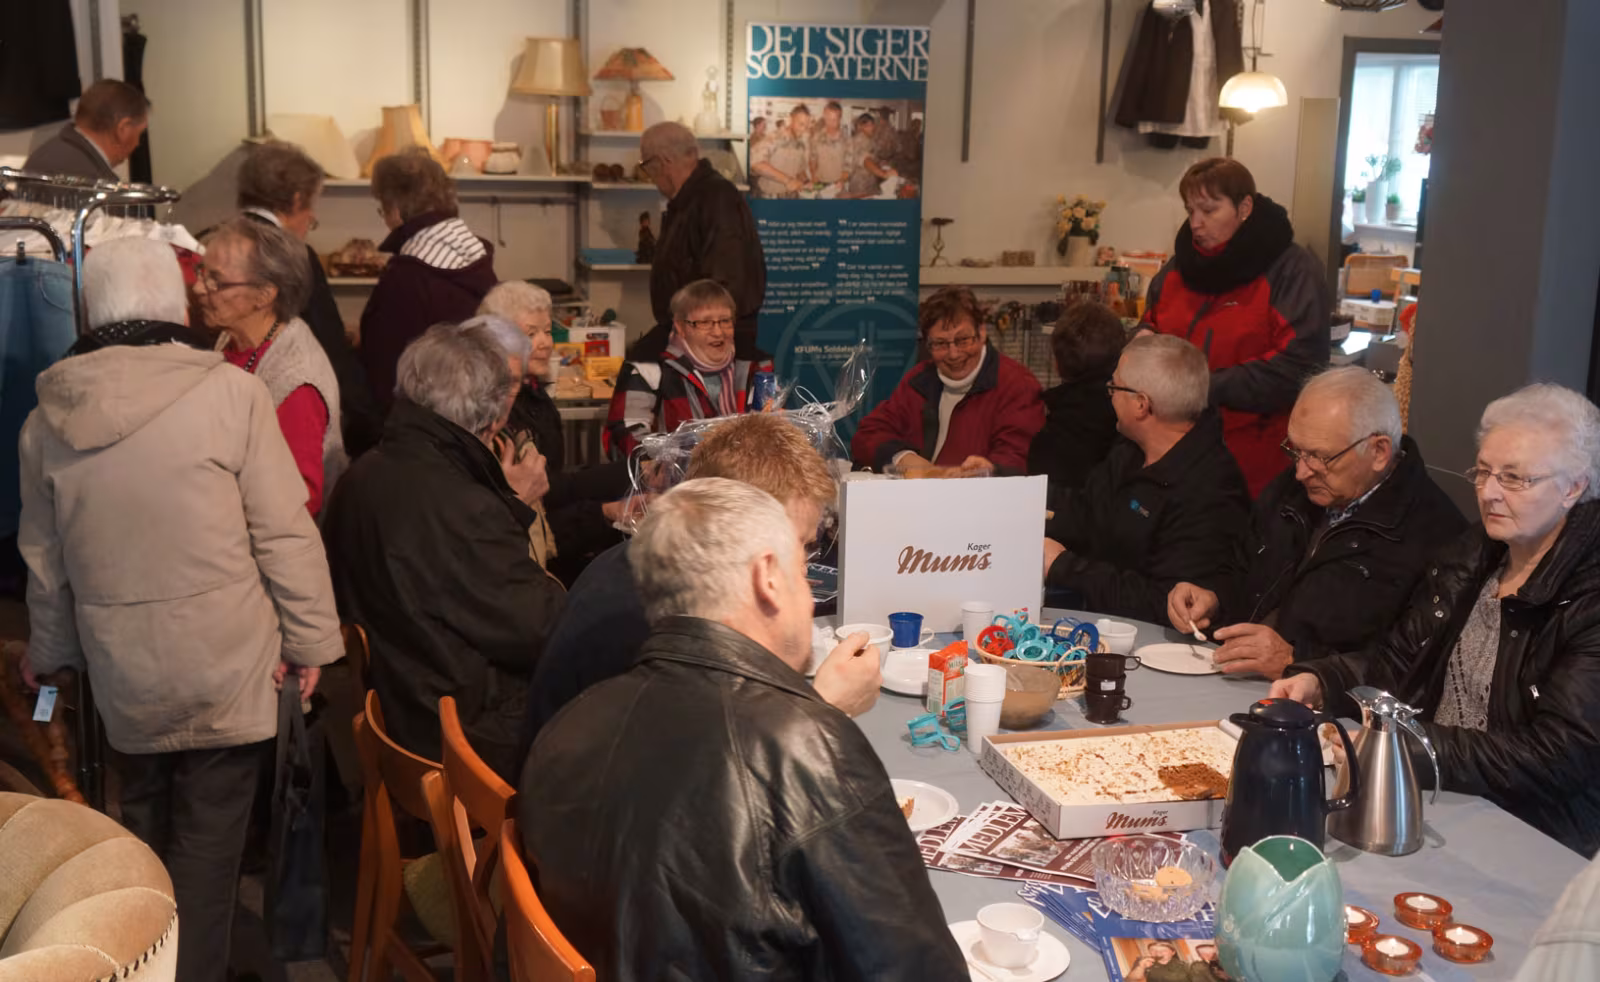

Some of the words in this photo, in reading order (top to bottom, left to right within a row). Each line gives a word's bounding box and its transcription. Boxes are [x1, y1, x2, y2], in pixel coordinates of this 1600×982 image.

[747, 24, 822, 58] DET
[825, 26, 929, 59] SIGER
[746, 52, 929, 81] SOLDATERNE
[897, 545, 992, 574] Mums
[1105, 811, 1168, 830] Mums
